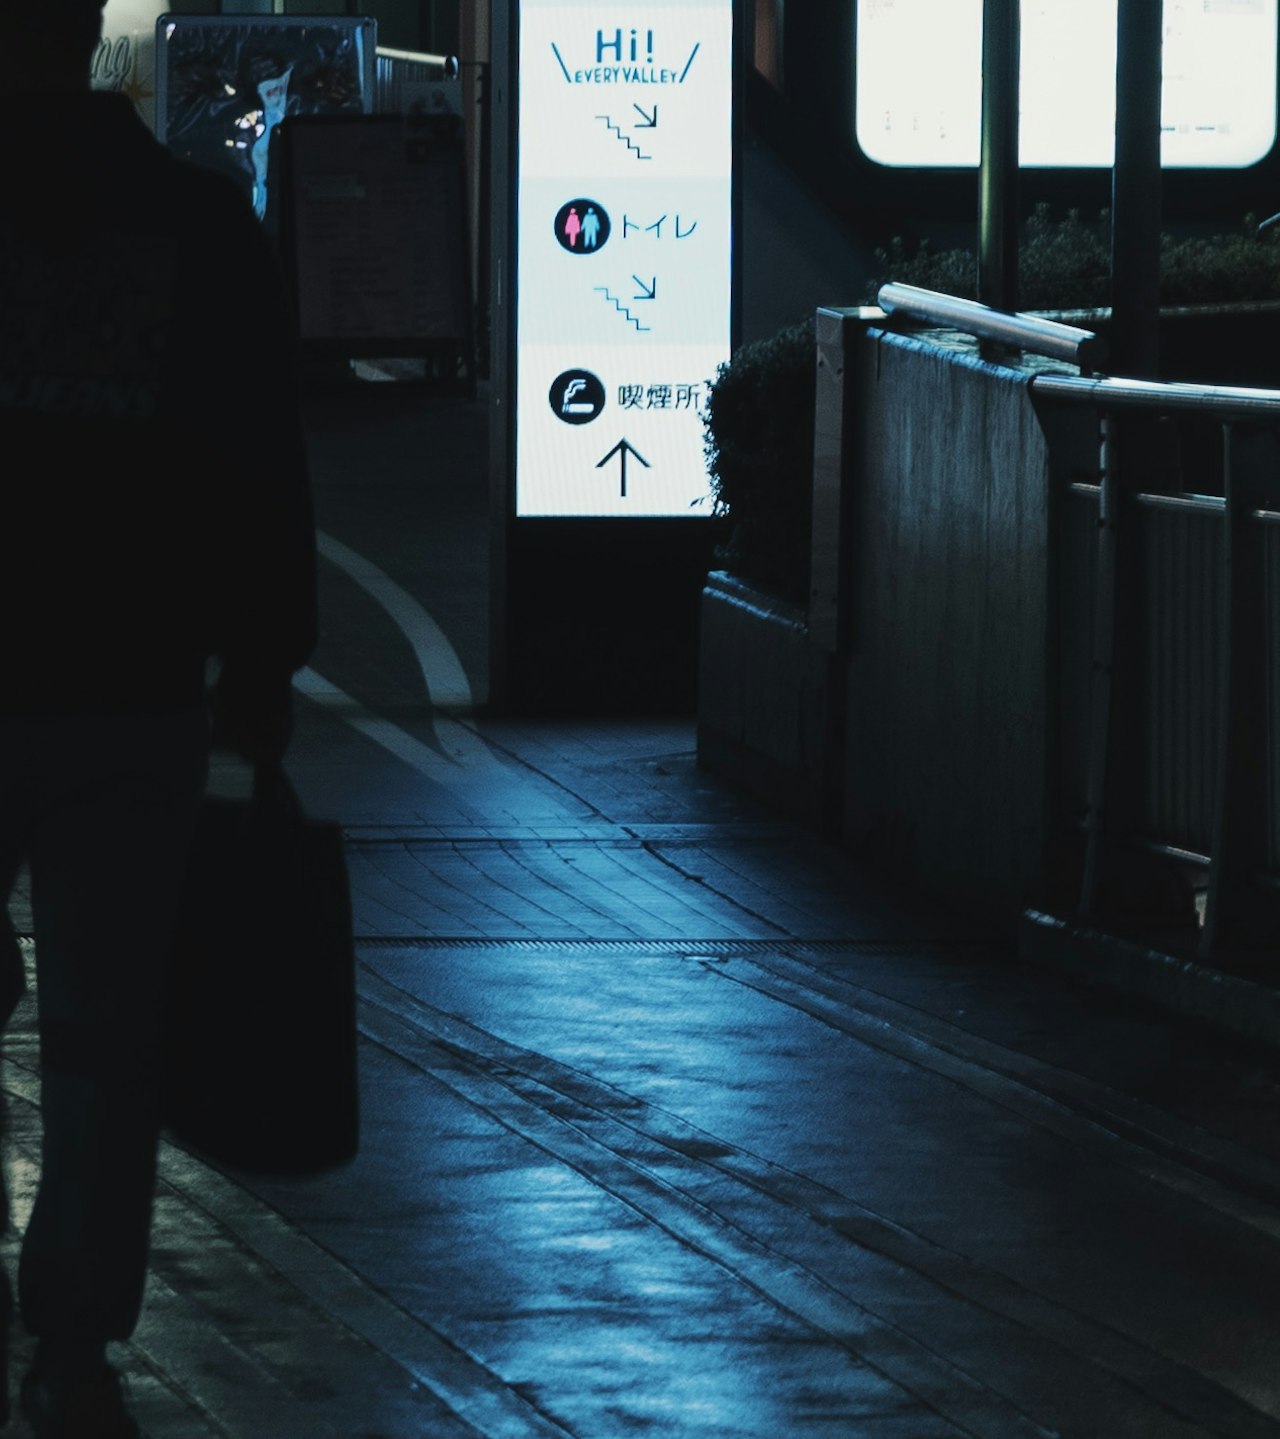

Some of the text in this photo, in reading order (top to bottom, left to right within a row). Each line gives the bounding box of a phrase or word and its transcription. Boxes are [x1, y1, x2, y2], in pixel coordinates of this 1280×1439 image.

[596, 28, 653, 63] Hi!
[574, 67, 678, 83] EVERY VALLEY
[623, 214, 697, 238] トイレ
[618, 383, 701, 410] 喫煙所
